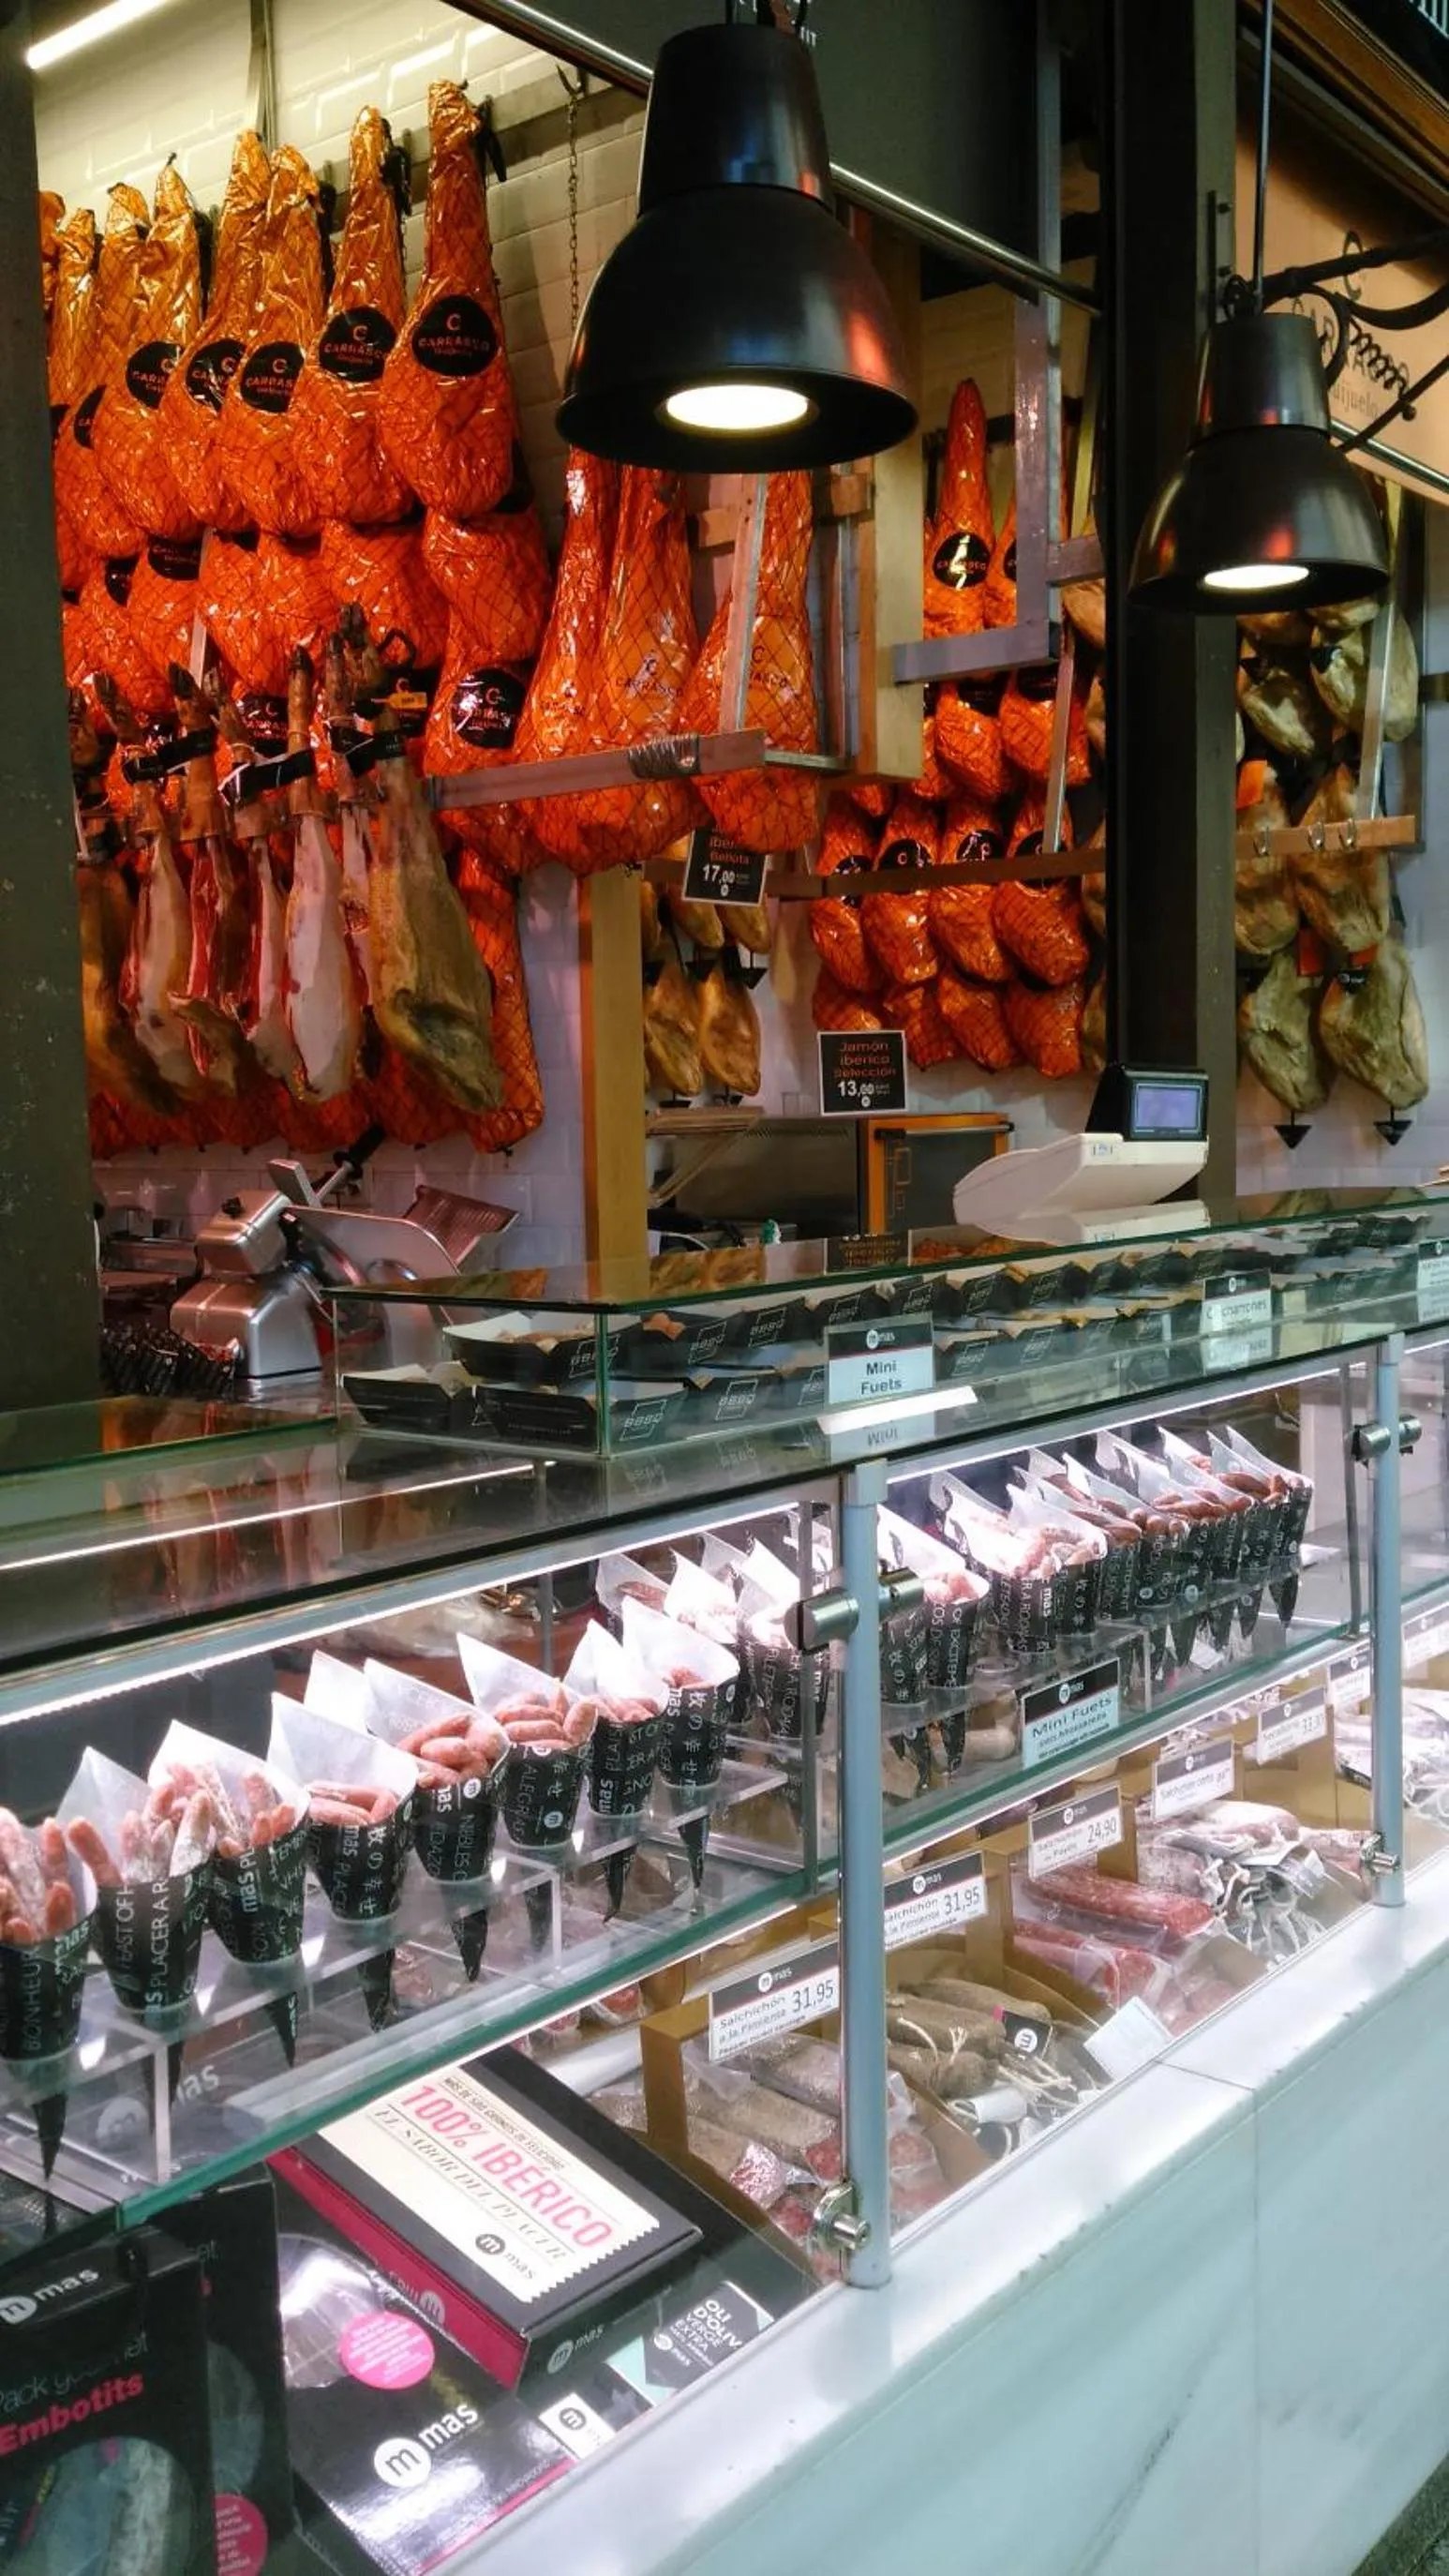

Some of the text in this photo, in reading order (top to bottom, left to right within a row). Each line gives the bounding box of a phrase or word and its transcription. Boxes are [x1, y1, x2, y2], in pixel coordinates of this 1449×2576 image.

[866, 1359, 897, 1375] Mini
[860, 1378, 903, 1395] Fuets
[1033, 1715, 1068, 1737] Mini
[1072, 1698, 1112, 1721] Fuets
[153, 1895, 170, 1910] A
[237, 1871, 258, 1913] mas
[944, 1885, 980, 1915] 31,95
[116, 1898, 134, 1922] OF
[151, 1915, 170, 1987] PLACER
[720, 1980, 834, 2029] Salchichón 31,95
[401, 2084, 613, 2247] 100% IBÉRICO
[404, 2129, 459, 2173] SABOR
[455, 2166, 491, 2198] DEL
[504, 2252, 536, 2280] mas
[34, 2269, 99, 2301] mas
[705, 2299, 732, 2324] OLI
[575, 2323, 605, 2351] mas
[675, 2319, 710, 2353] EXTRA
[0, 2373, 143, 2457] Embotits
[418, 2403, 479, 2451] mas
